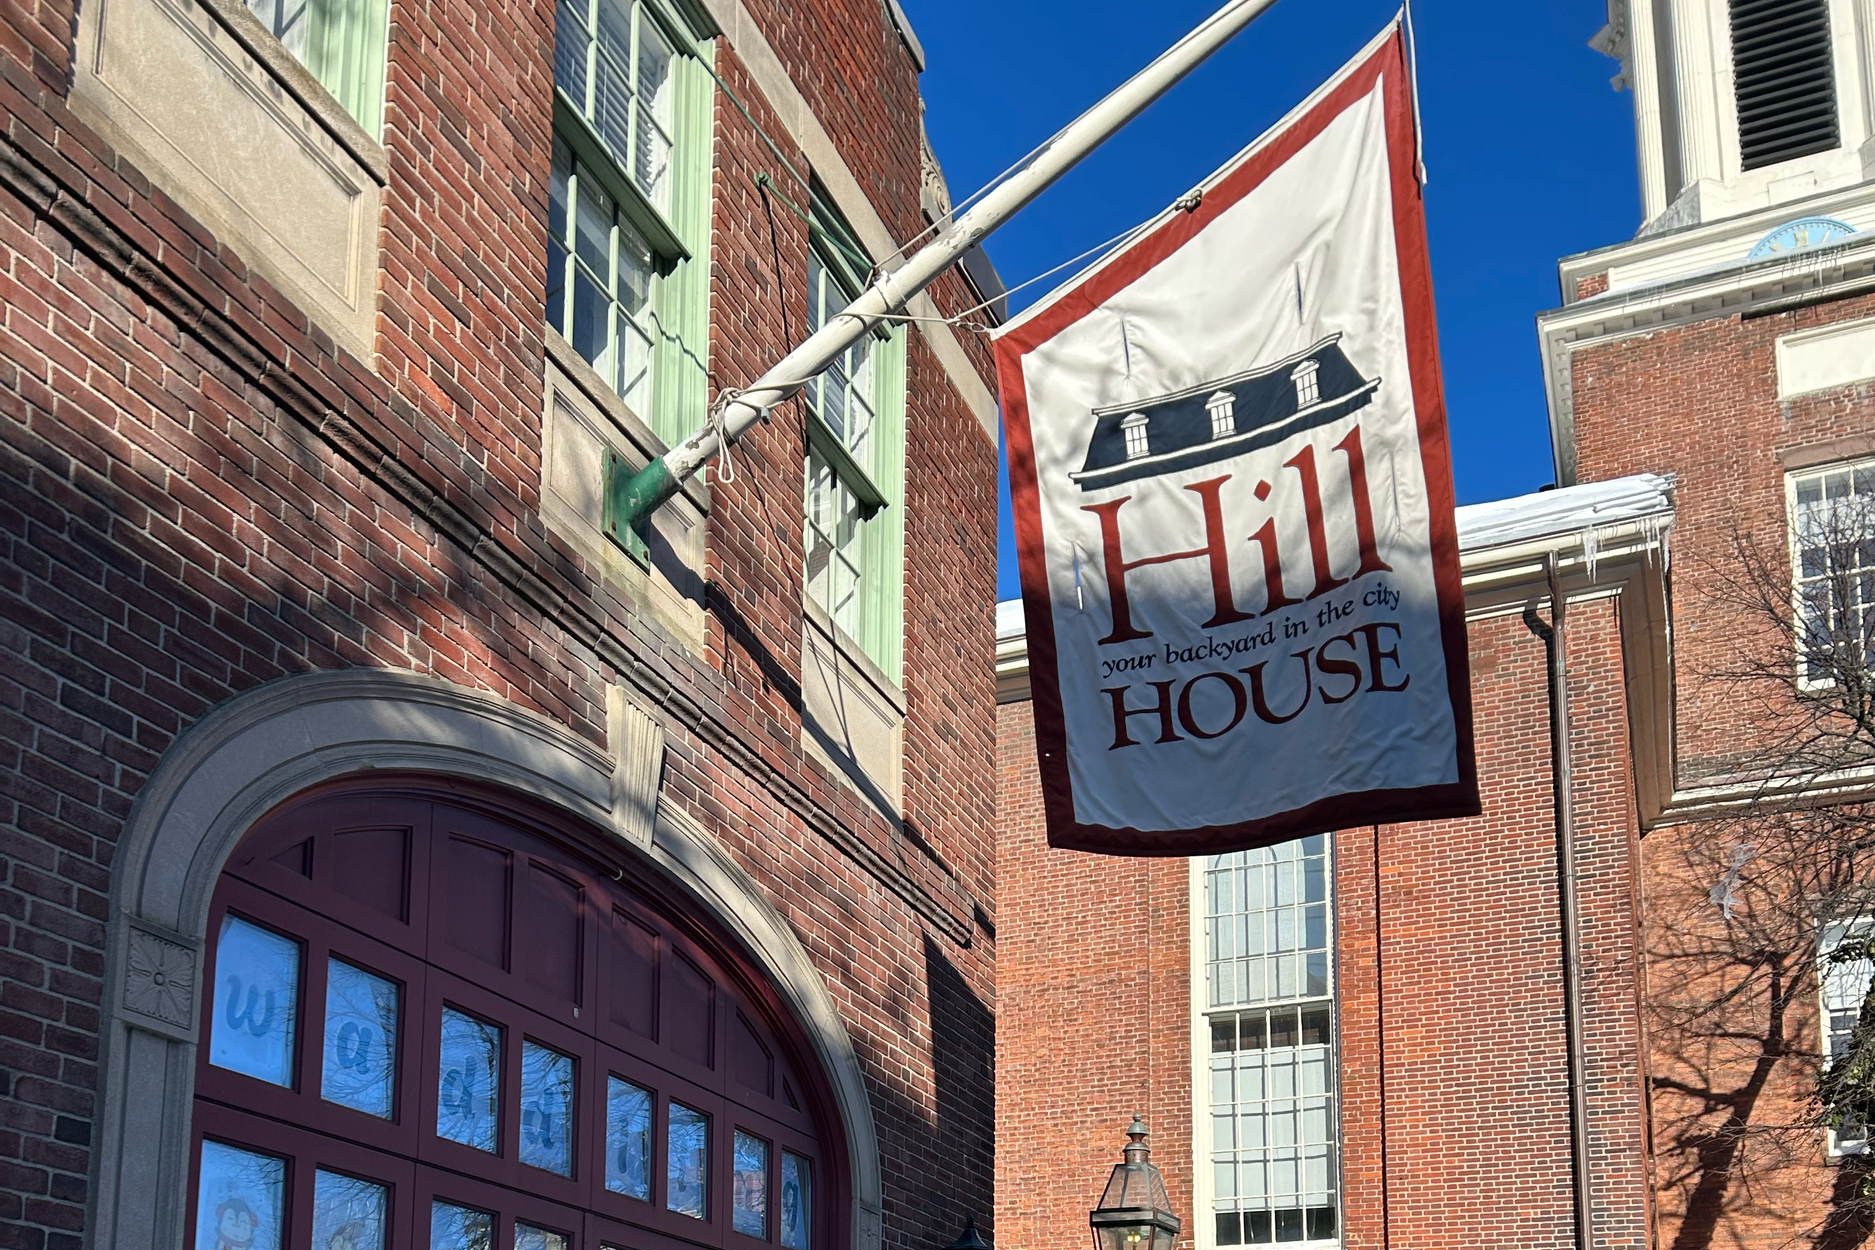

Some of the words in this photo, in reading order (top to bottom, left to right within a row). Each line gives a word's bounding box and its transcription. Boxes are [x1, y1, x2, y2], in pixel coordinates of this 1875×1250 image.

[1080, 423, 1393, 646] Hill
[1100, 622, 1410, 751] HOUSE
[1102, 653, 1156, 678] your
[1165, 622, 1276, 665] backyard
[1284, 616, 1309, 638] in
[1316, 601, 1354, 629] the
[1363, 582, 1401, 611] city
